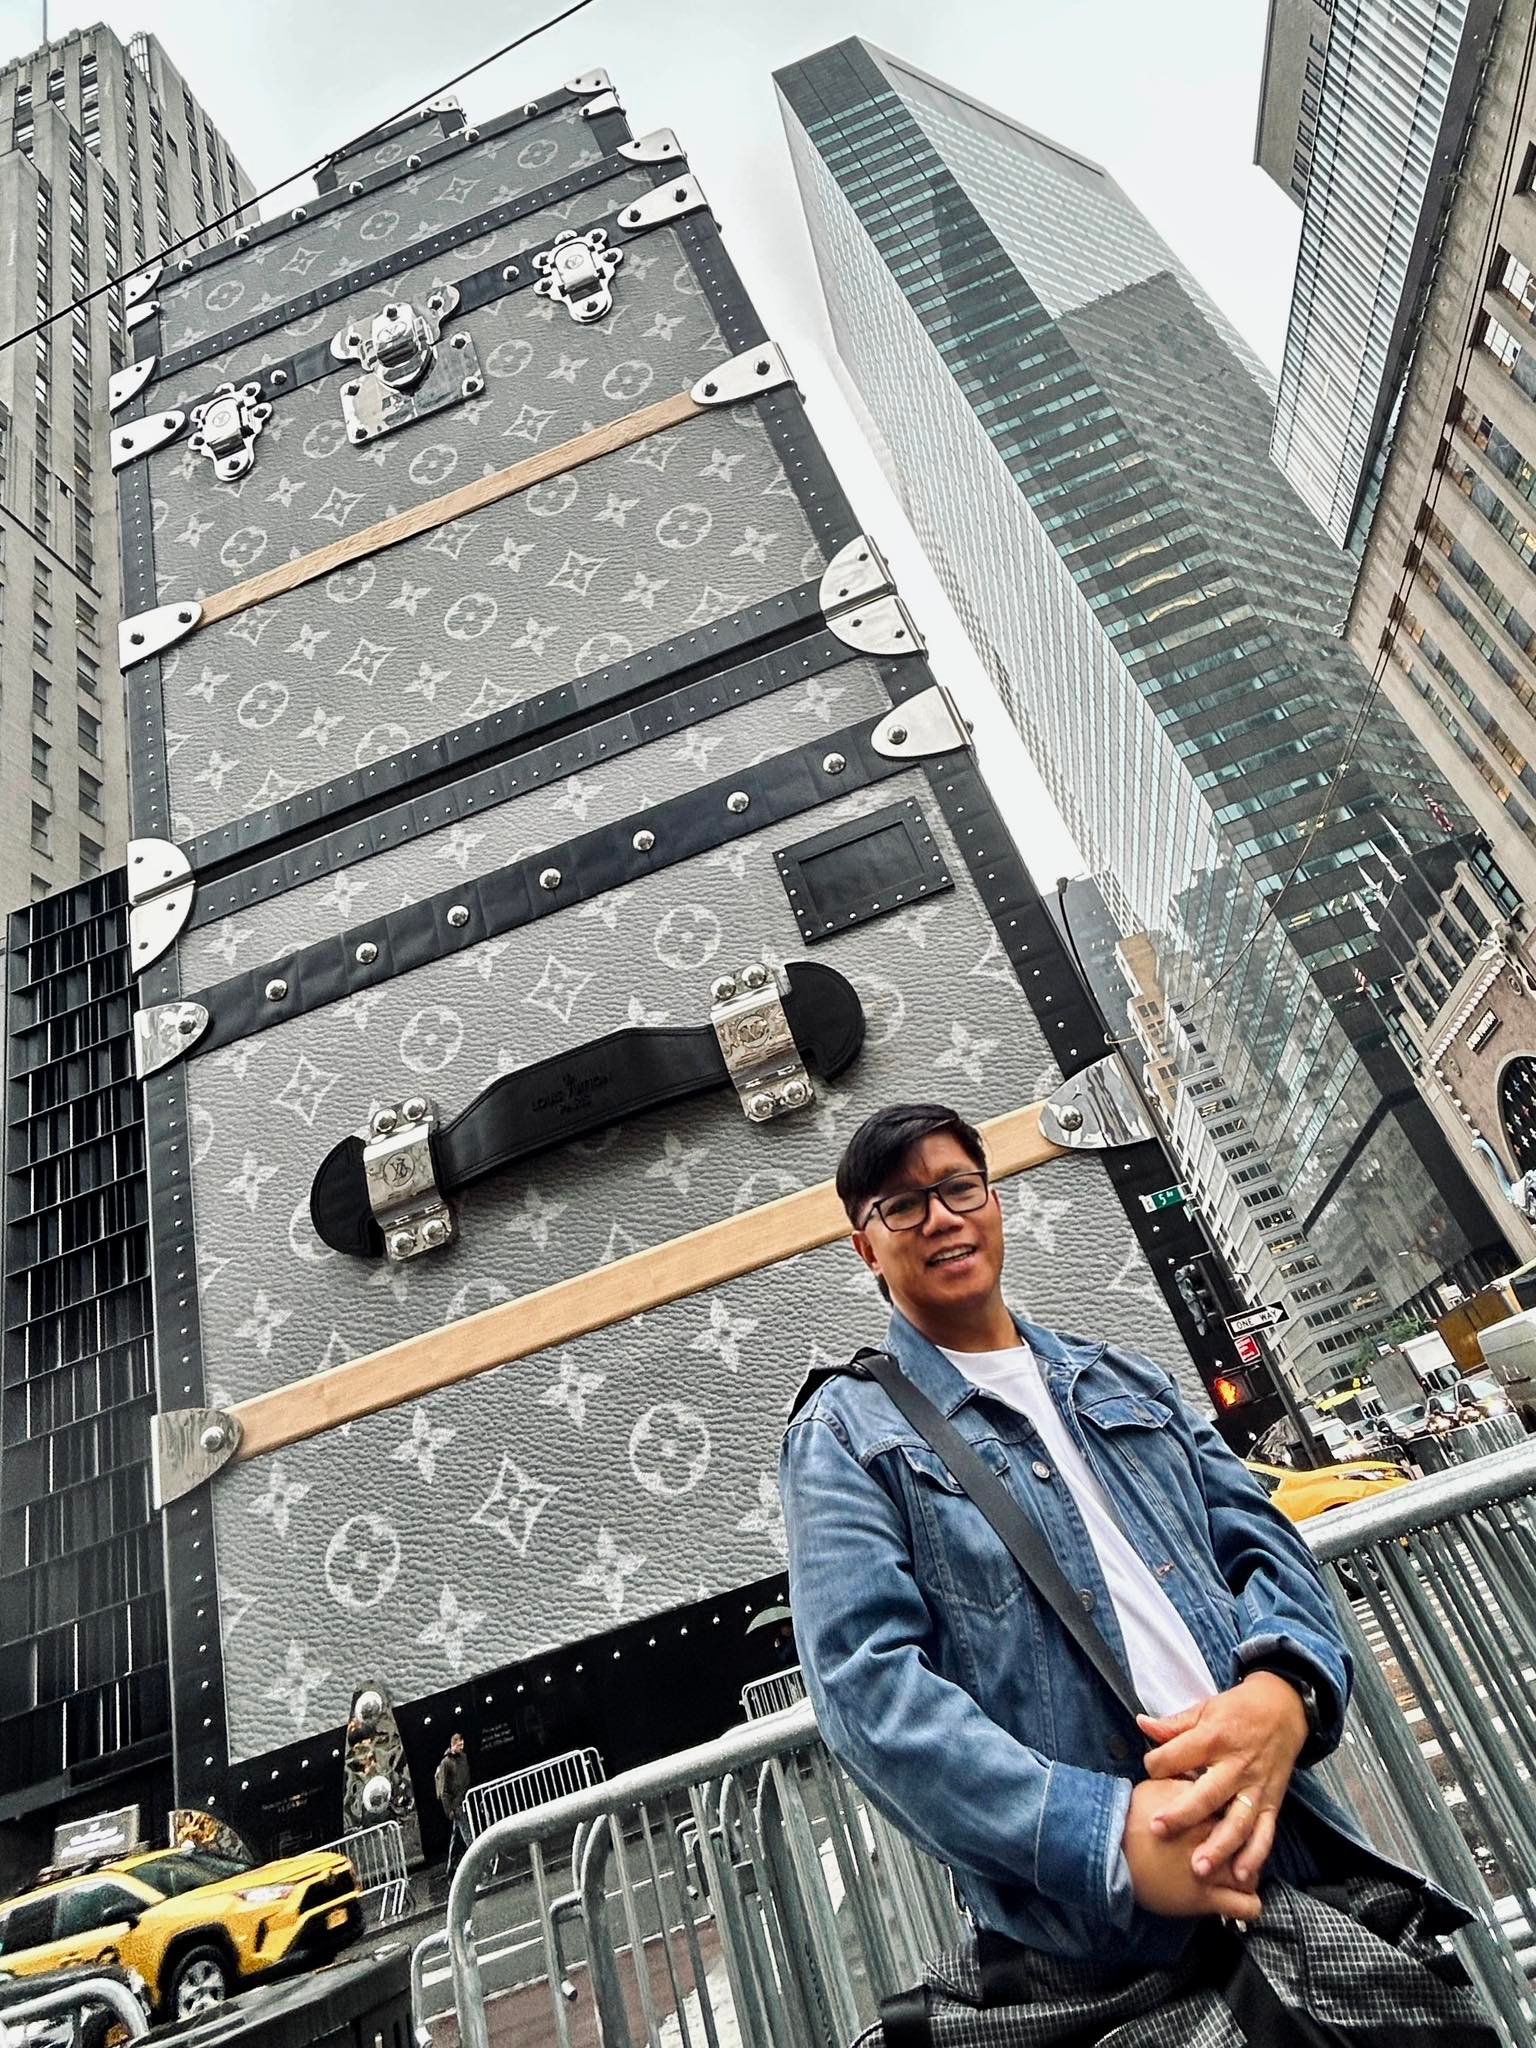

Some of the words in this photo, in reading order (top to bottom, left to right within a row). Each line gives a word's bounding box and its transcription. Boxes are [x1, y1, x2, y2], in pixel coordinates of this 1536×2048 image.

[1158, 1194, 1167, 1206] 5
[1236, 1318, 1254, 1329] ONE
[1259, 1310, 1277, 1321] WAY
